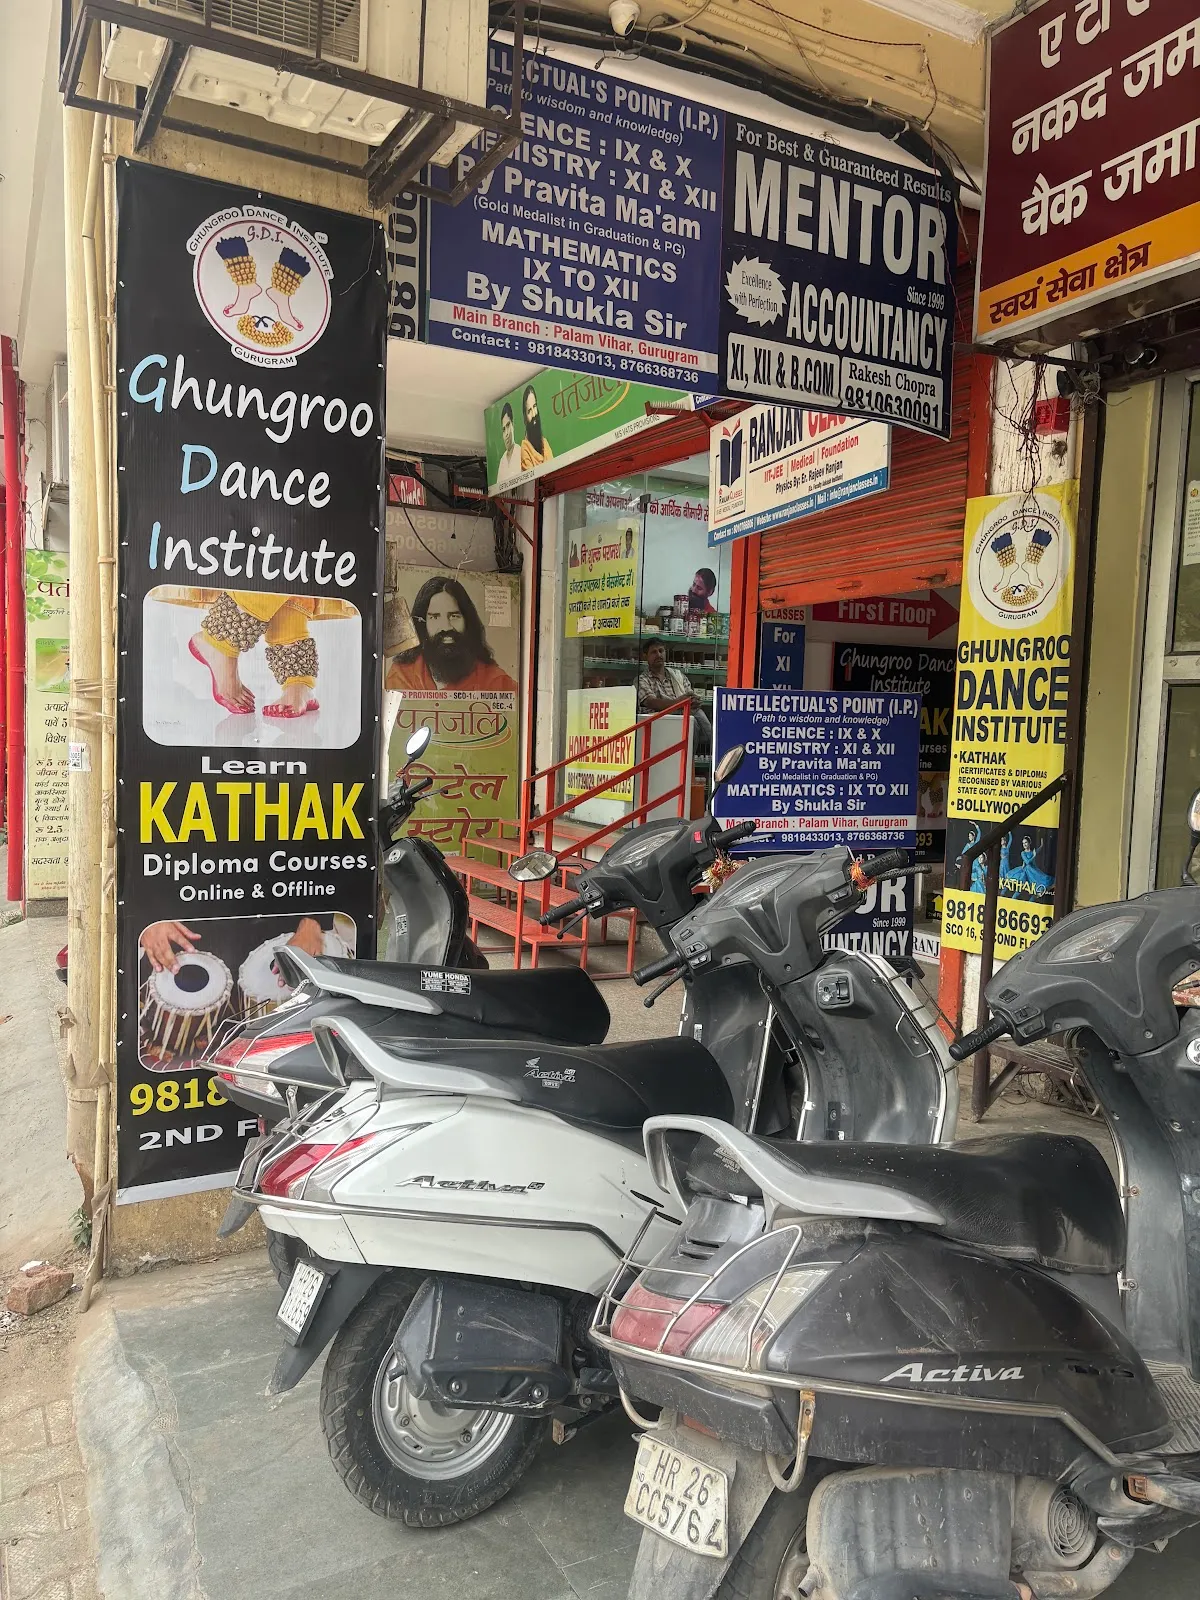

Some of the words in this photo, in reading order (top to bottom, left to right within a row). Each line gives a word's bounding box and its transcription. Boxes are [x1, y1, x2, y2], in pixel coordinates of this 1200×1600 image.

[537, 92, 585, 119] wisdom
[589, 106, 612, 126] and
[615, 114, 683, 146] knowledge)
[614, 86, 672, 122] POINT
[678, 105, 719, 140] (I.P.)
[1011, 68, 1112, 157] नकद
[615, 138, 641, 165] IX
[650, 147, 667, 172] &
[675, 154, 692, 179] X
[736, 122, 762, 147] For
[766, 130, 799, 158] Best
[803, 142, 815, 163] &
[818, 147, 899, 188] Guaranteed
[903, 171, 951, 204] Results
[1021, 172, 1093, 236] चैक
[1100, 117, 1200, 202] जमा
[624, 168, 650, 194] XI
[659, 178, 676, 202] &
[684, 186, 717, 212] XII
[246, 208, 284, 225] DANCE
[504, 166, 606, 218] Pravita
[615, 194, 701, 241] Ma'am
[473, 194, 509, 215] (Gold
[512, 204, 565, 230] Medalist
[569, 217, 580, 231] in
[583, 221, 649, 247] Graduation
[664, 240, 686, 259] PG)
[734, 149, 947, 286] MENTOR
[247, 225, 284, 243] G.D.I.
[482, 218, 677, 284] MATHEMATICS
[522, 256, 551, 283] IX
[559, 265, 596, 291] TO
[603, 273, 639, 302] XII
[742, 270, 772, 291] Excellence
[989, 276, 1044, 325] स्वयं
[1045, 262, 1097, 303] सेवा
[1104, 240, 1152, 279] क्षेत्र
[467, 271, 511, 311] By
[522, 284, 634, 331] Shukla
[644, 308, 688, 341] Sir
[906, 286, 926, 307] Since
[927, 292, 945, 311] 1999
[453, 304, 487, 326] Main
[492, 314, 540, 337] Branch
[553, 325, 596, 347] Palam
[598, 333, 635, 355] Vihar,
[638, 341, 699, 366] Gurugram
[786, 280, 947, 372] ACCOUNTANCY
[234, 346, 295, 365] GURUGRAM
[451, 327, 511, 350] Contact
[527, 341, 616, 371] 9818433013,
[620, 357, 699, 385] 8766368736
[753, 346, 771, 385] XII
[791, 355, 834, 398] B.COM
[848, 362, 892, 388] Rakesh
[895, 373, 936, 398] Chopra
[129, 354, 373, 444] Ghungroo
[844, 385, 939, 428] 9810630091
[749, 406, 803, 464] RANJAN
[764, 463, 784, 485] IIT-JEE
[790, 451, 815, 474] Medical
[820, 434, 859, 461] Foundation
[180, 444, 331, 508] Dance
[775, 478, 793, 495] Physics
[808, 467, 825, 483] Rajeev
[825, 459, 843, 475] Ranjan
[149, 521, 357, 588] Institute
[765, 609, 805, 622] CLASSES
[838, 600, 885, 622] First
[889, 602, 937, 625] Floor
[998, 609, 1038, 621] GURUGRAM
[773, 627, 796, 644] For
[957, 635, 1071, 664] GHUNGROO
[775, 655, 791, 672] XI
[408, 691, 448, 699] PROVISIONS
[480, 691, 498, 700] HUDA
[499, 692, 515, 701] MKT.
[870, 674, 931, 696] Institute
[957, 666, 1070, 711] DANCE
[491, 702, 513, 710] SEC.-4
[589, 702, 610, 730] FREE
[721, 694, 838, 714] INTELLECTUAL'S
[842, 697, 884, 715] POINT
[888, 698, 918, 719] (I.P.)
[752, 713, 776, 724] (Path
[788, 714, 822, 724] wisdom
[824, 714, 841, 724] and
[842, 715, 890, 726] knowledge)
[955, 715, 1067, 745] INSTITUTE
[761, 726, 825, 739] SCIENCE
[838, 727, 853, 740] IX
[871, 728, 881, 740] X
[591, 735, 632, 765] DELIVERY
[745, 741, 830, 756] CHEMISTRY
[842, 743, 857, 756] XI
[876, 743, 895, 756] XII
[959, 750, 1007, 765] KATHAK
[201, 756, 308, 775] Learn
[758, 757, 777, 772] By
[781, 757, 832, 770] Pravita
[836, 758, 881, 770] Ma'am
[761, 772, 781, 782] (Gold
[782, 773, 811, 781] Medalist
[820, 773, 858, 781] Graduation
[959, 766, 1006, 777] (CERTIFICATES
[1015, 769, 1048, 779] DIPLOMAS
[727, 783, 836, 797] MATHEMATICS
[848, 783, 864, 796] IX
[867, 784, 886, 797] TO
[889, 783, 909, 796] XII
[957, 776, 1000, 787] RECOGNISED
[1011, 779, 1042, 789] VARIOUS
[957, 786, 977, 795] STATE
[978, 787, 998, 797] GOVT.
[139, 782, 366, 844] KATHAK
[771, 800, 790, 814] By
[794, 799, 843, 812] Shukla
[846, 799, 867, 812] Sir
[46, 825, 63, 834] 2.5
[754, 817, 789, 829] Branch
[799, 817, 829, 829] Palam
[832, 817, 859, 830] Vihar,
[862, 817, 908, 830] Gurugram
[781, 832, 845, 844] 9818433013,
[847, 831, 905, 842] 8766368736
[143, 853, 259, 881] Diploma
[269, 850, 368, 871] Courses
[179, 884, 245, 902] Online
[251, 883, 265, 899] &
[272, 880, 336, 898] Offline
[872, 917, 890, 928] Since
[890, 916, 907, 927] 1999
[945, 923, 963, 936] SCO
[423, 971, 444, 979] YUME
[444, 972, 469, 981] HONDA
[139, 1124, 224, 1151] 2ND
[394, 1175, 528, 1195] Activa
[879, 1362, 1025, 1382] Activa
[652, 1449, 682, 1491] HR
[683, 1466, 715, 1506] 26
